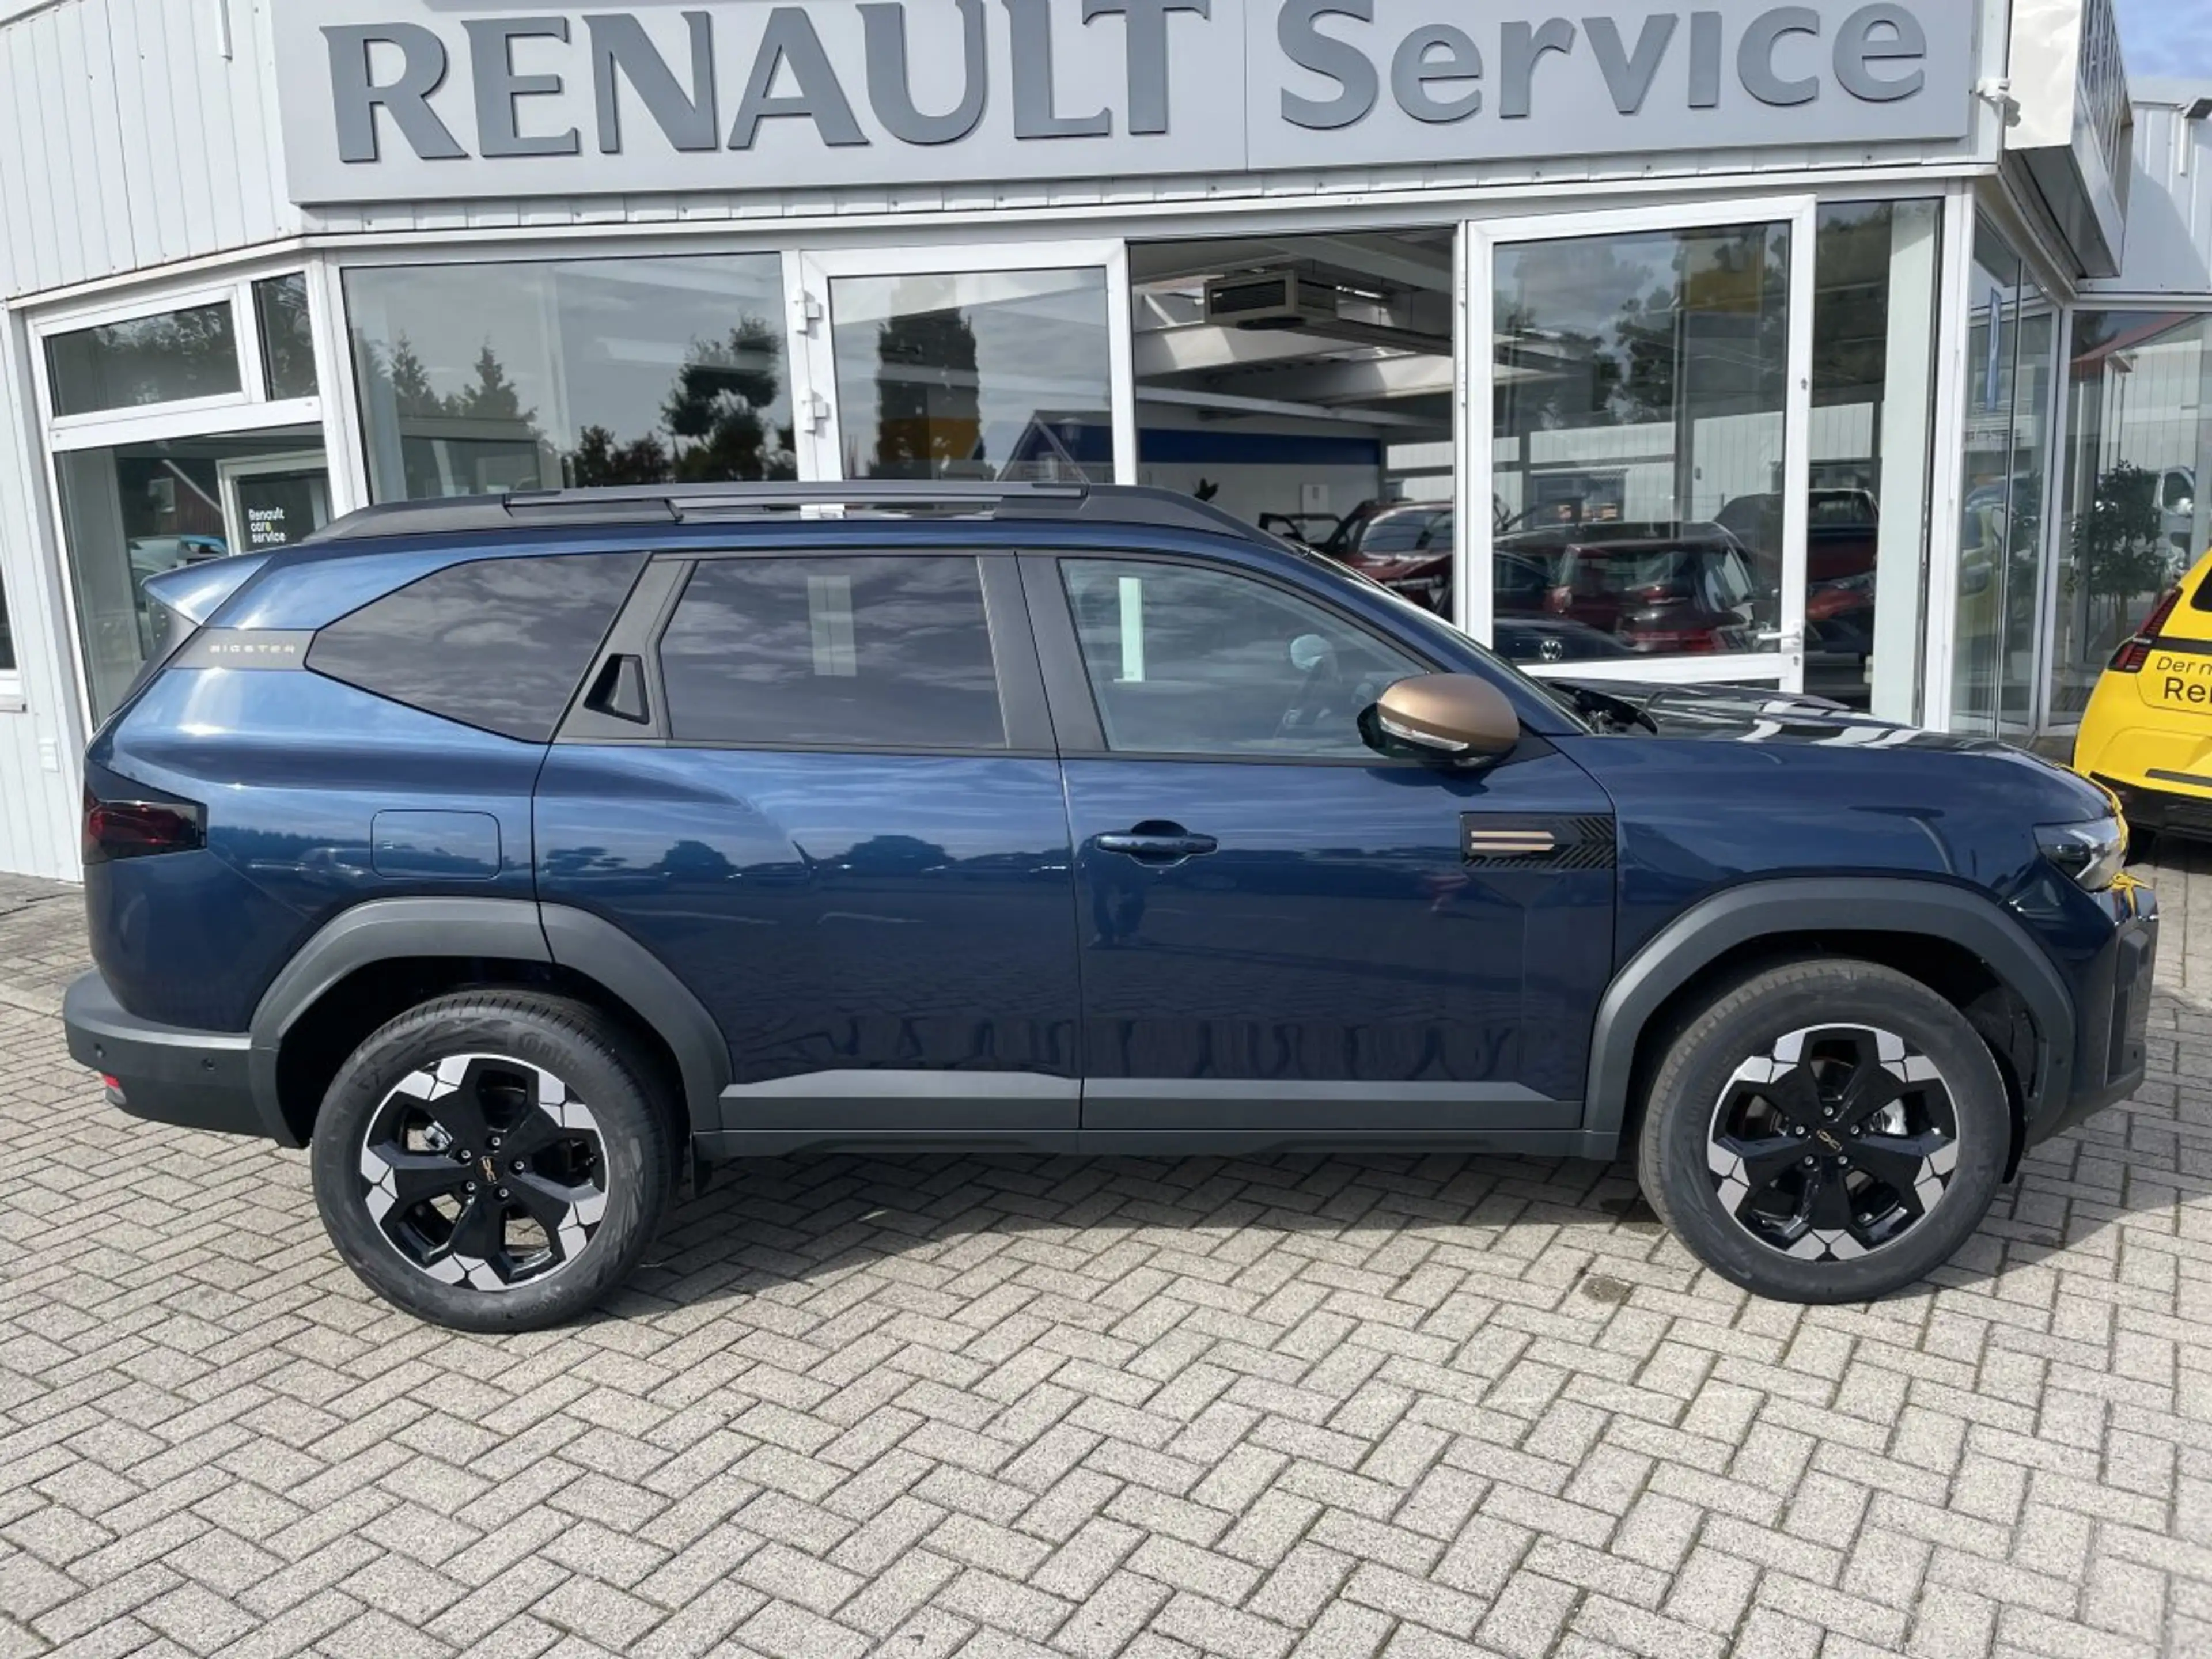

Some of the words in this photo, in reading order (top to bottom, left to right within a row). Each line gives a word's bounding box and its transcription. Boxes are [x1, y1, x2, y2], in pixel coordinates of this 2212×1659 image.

[319, 0, 1210, 162] RENAULT
[1277, 0, 1926, 130] Service
[248, 507, 285, 520] Renault
[251, 521, 271, 532] care
[252, 531, 286, 543] service
[2156, 656, 2196, 673] Der
[2164, 676, 2212, 704] Re
